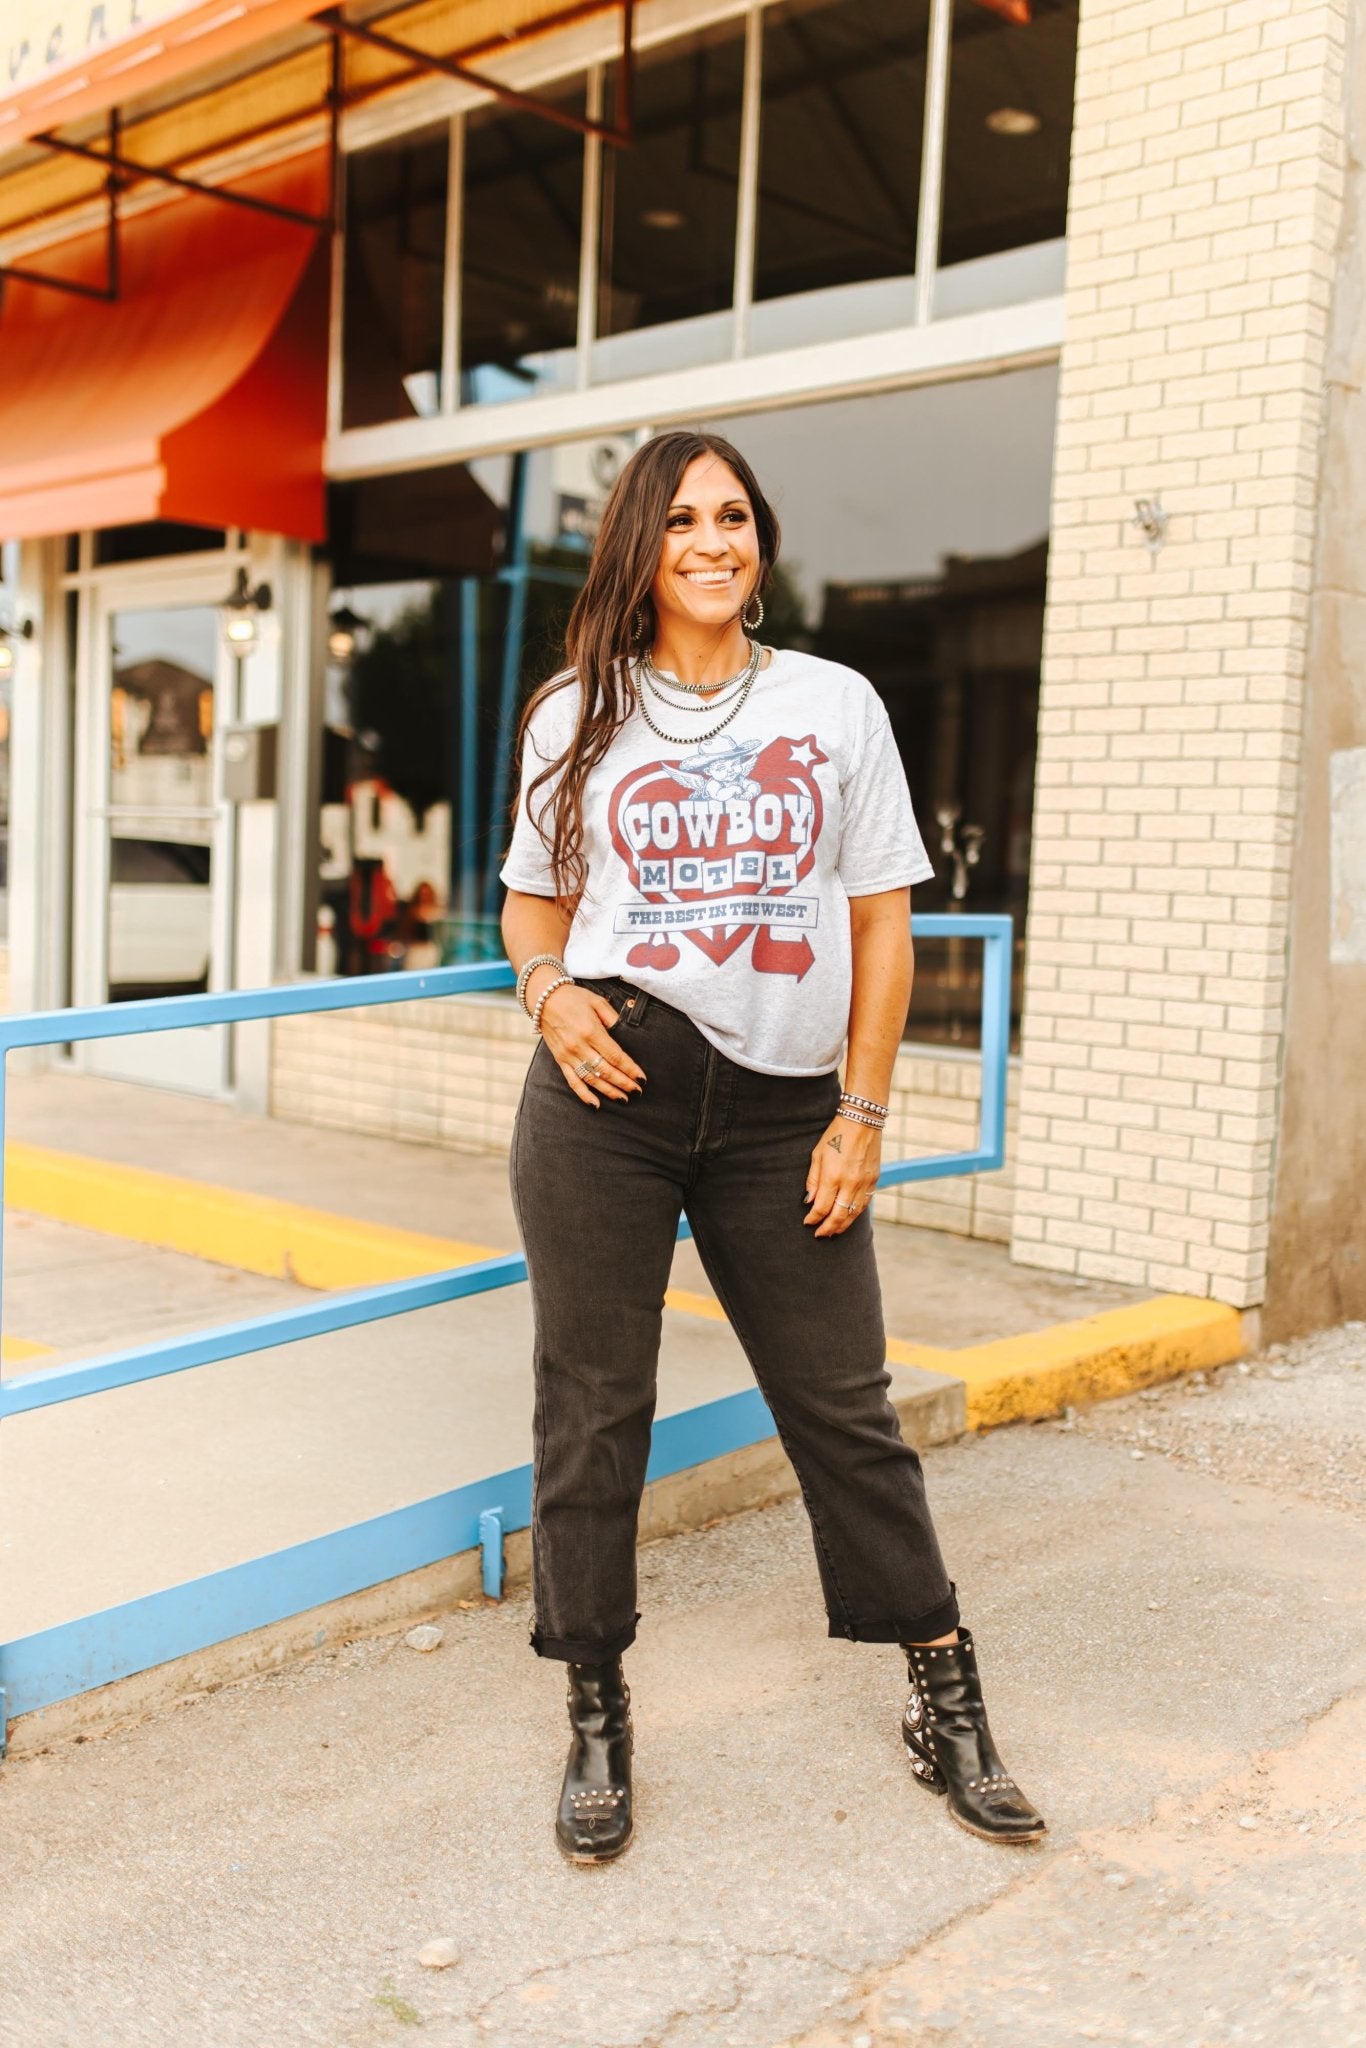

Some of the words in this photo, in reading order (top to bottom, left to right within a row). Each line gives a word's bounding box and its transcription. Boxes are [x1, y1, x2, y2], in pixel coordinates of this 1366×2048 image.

[623, 793, 813, 851] COWBOY
[643, 856, 791, 886] MOTEL
[628, 911, 662, 925] THE
[664, 908, 707, 924] BEST
[708, 904, 727, 920] IN
[729, 902, 760, 916] THE
[760, 902, 808, 919] WEST
